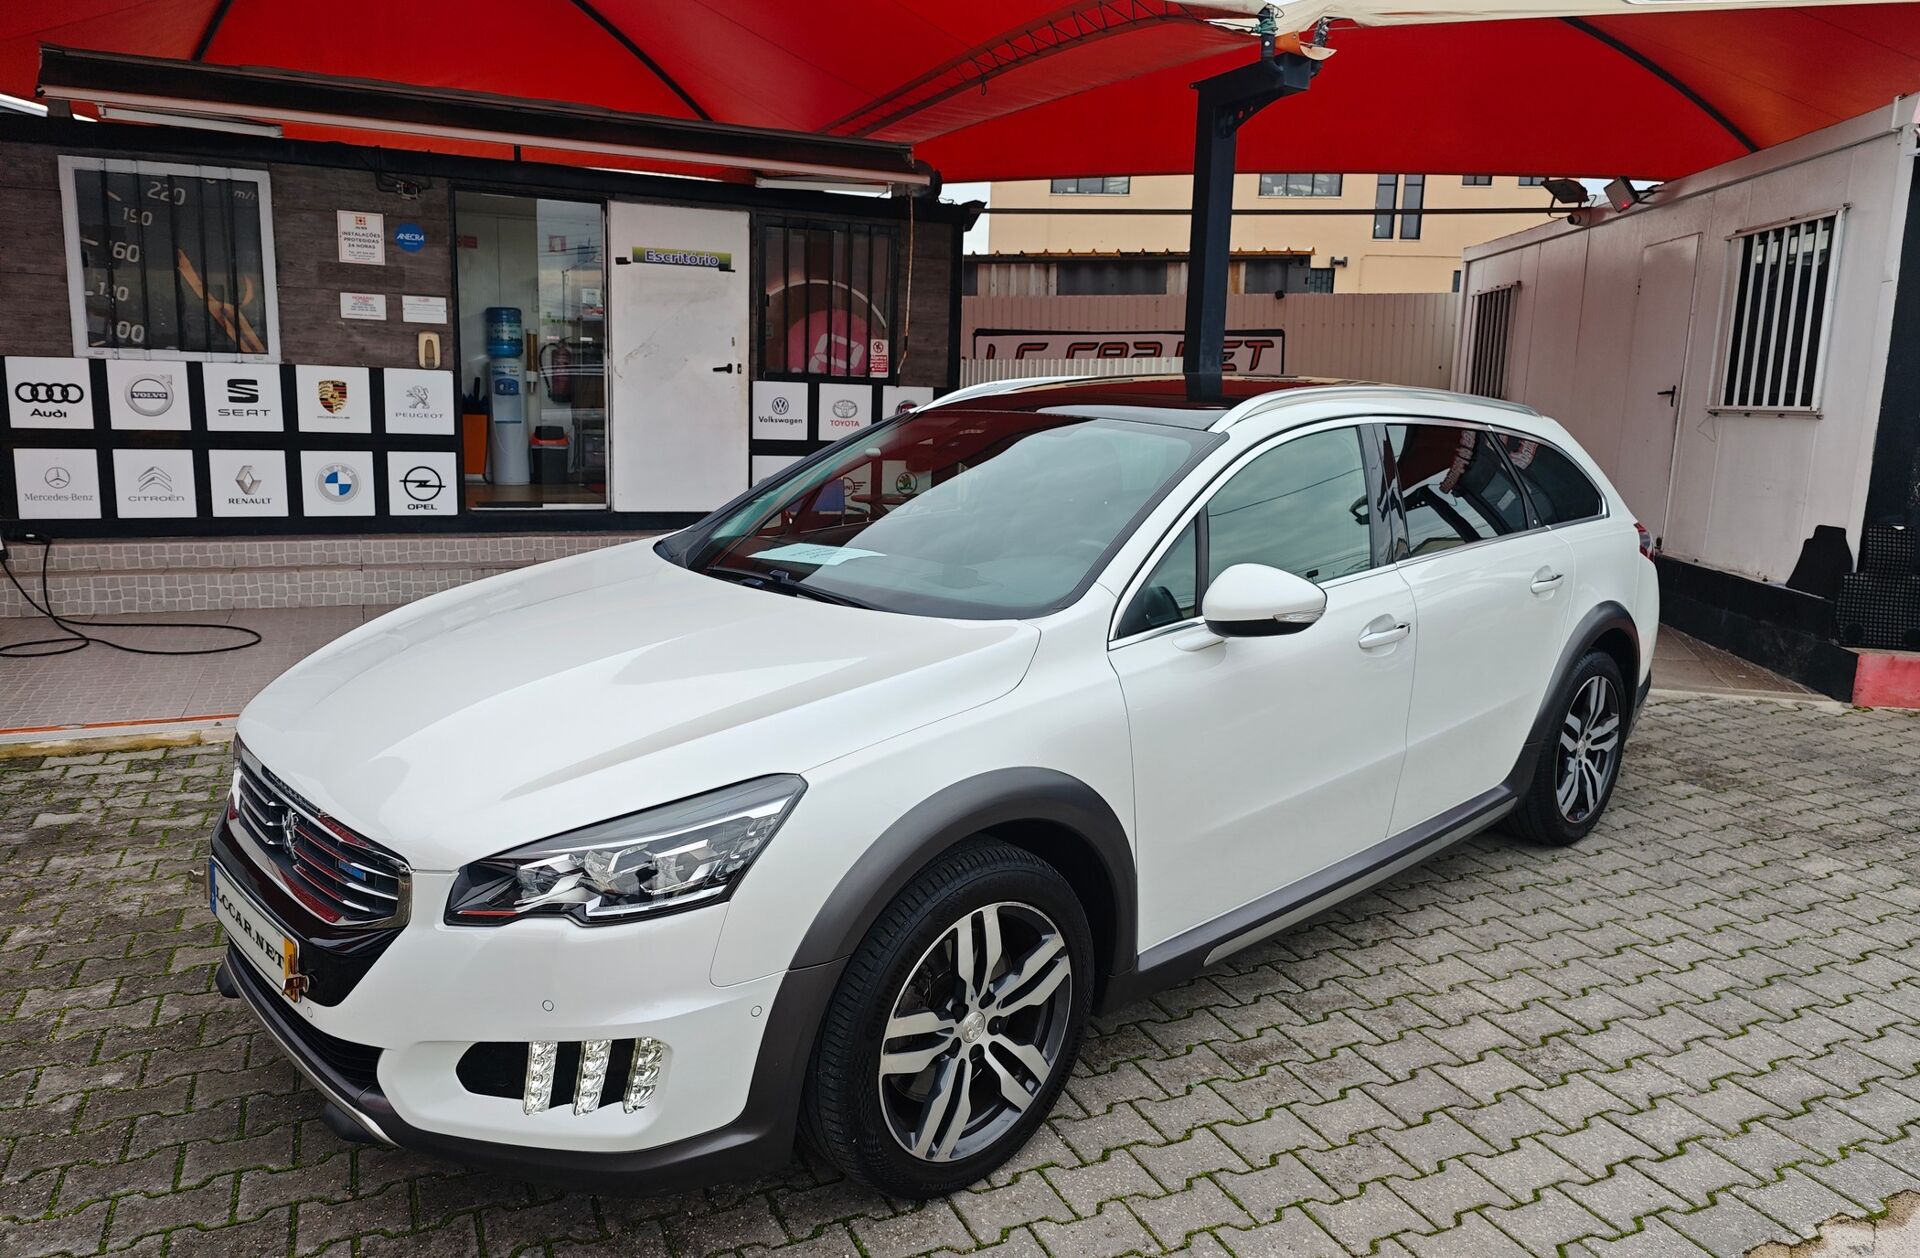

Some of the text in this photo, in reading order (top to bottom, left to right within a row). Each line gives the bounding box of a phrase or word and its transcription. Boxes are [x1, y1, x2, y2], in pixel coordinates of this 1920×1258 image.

[396, 233, 425, 241] ANECRA
[110, 240, 141, 263] 60
[645, 250, 719, 266] Escritório
[98, 282, 129, 302] 10
[109, 321, 145, 343] 00
[132, 391, 167, 399] VOLVO
[30, 408, 67, 418] Audi
[217, 408, 271, 417] SEAT
[758, 416, 803, 425] Volkswagen
[830, 419, 860, 427] TOYOTA
[24, 493, 93, 502] Mercedes-Benz
[228, 497, 272, 505] RENAULT
[216, 886, 285, 970] LCCAR.NET
